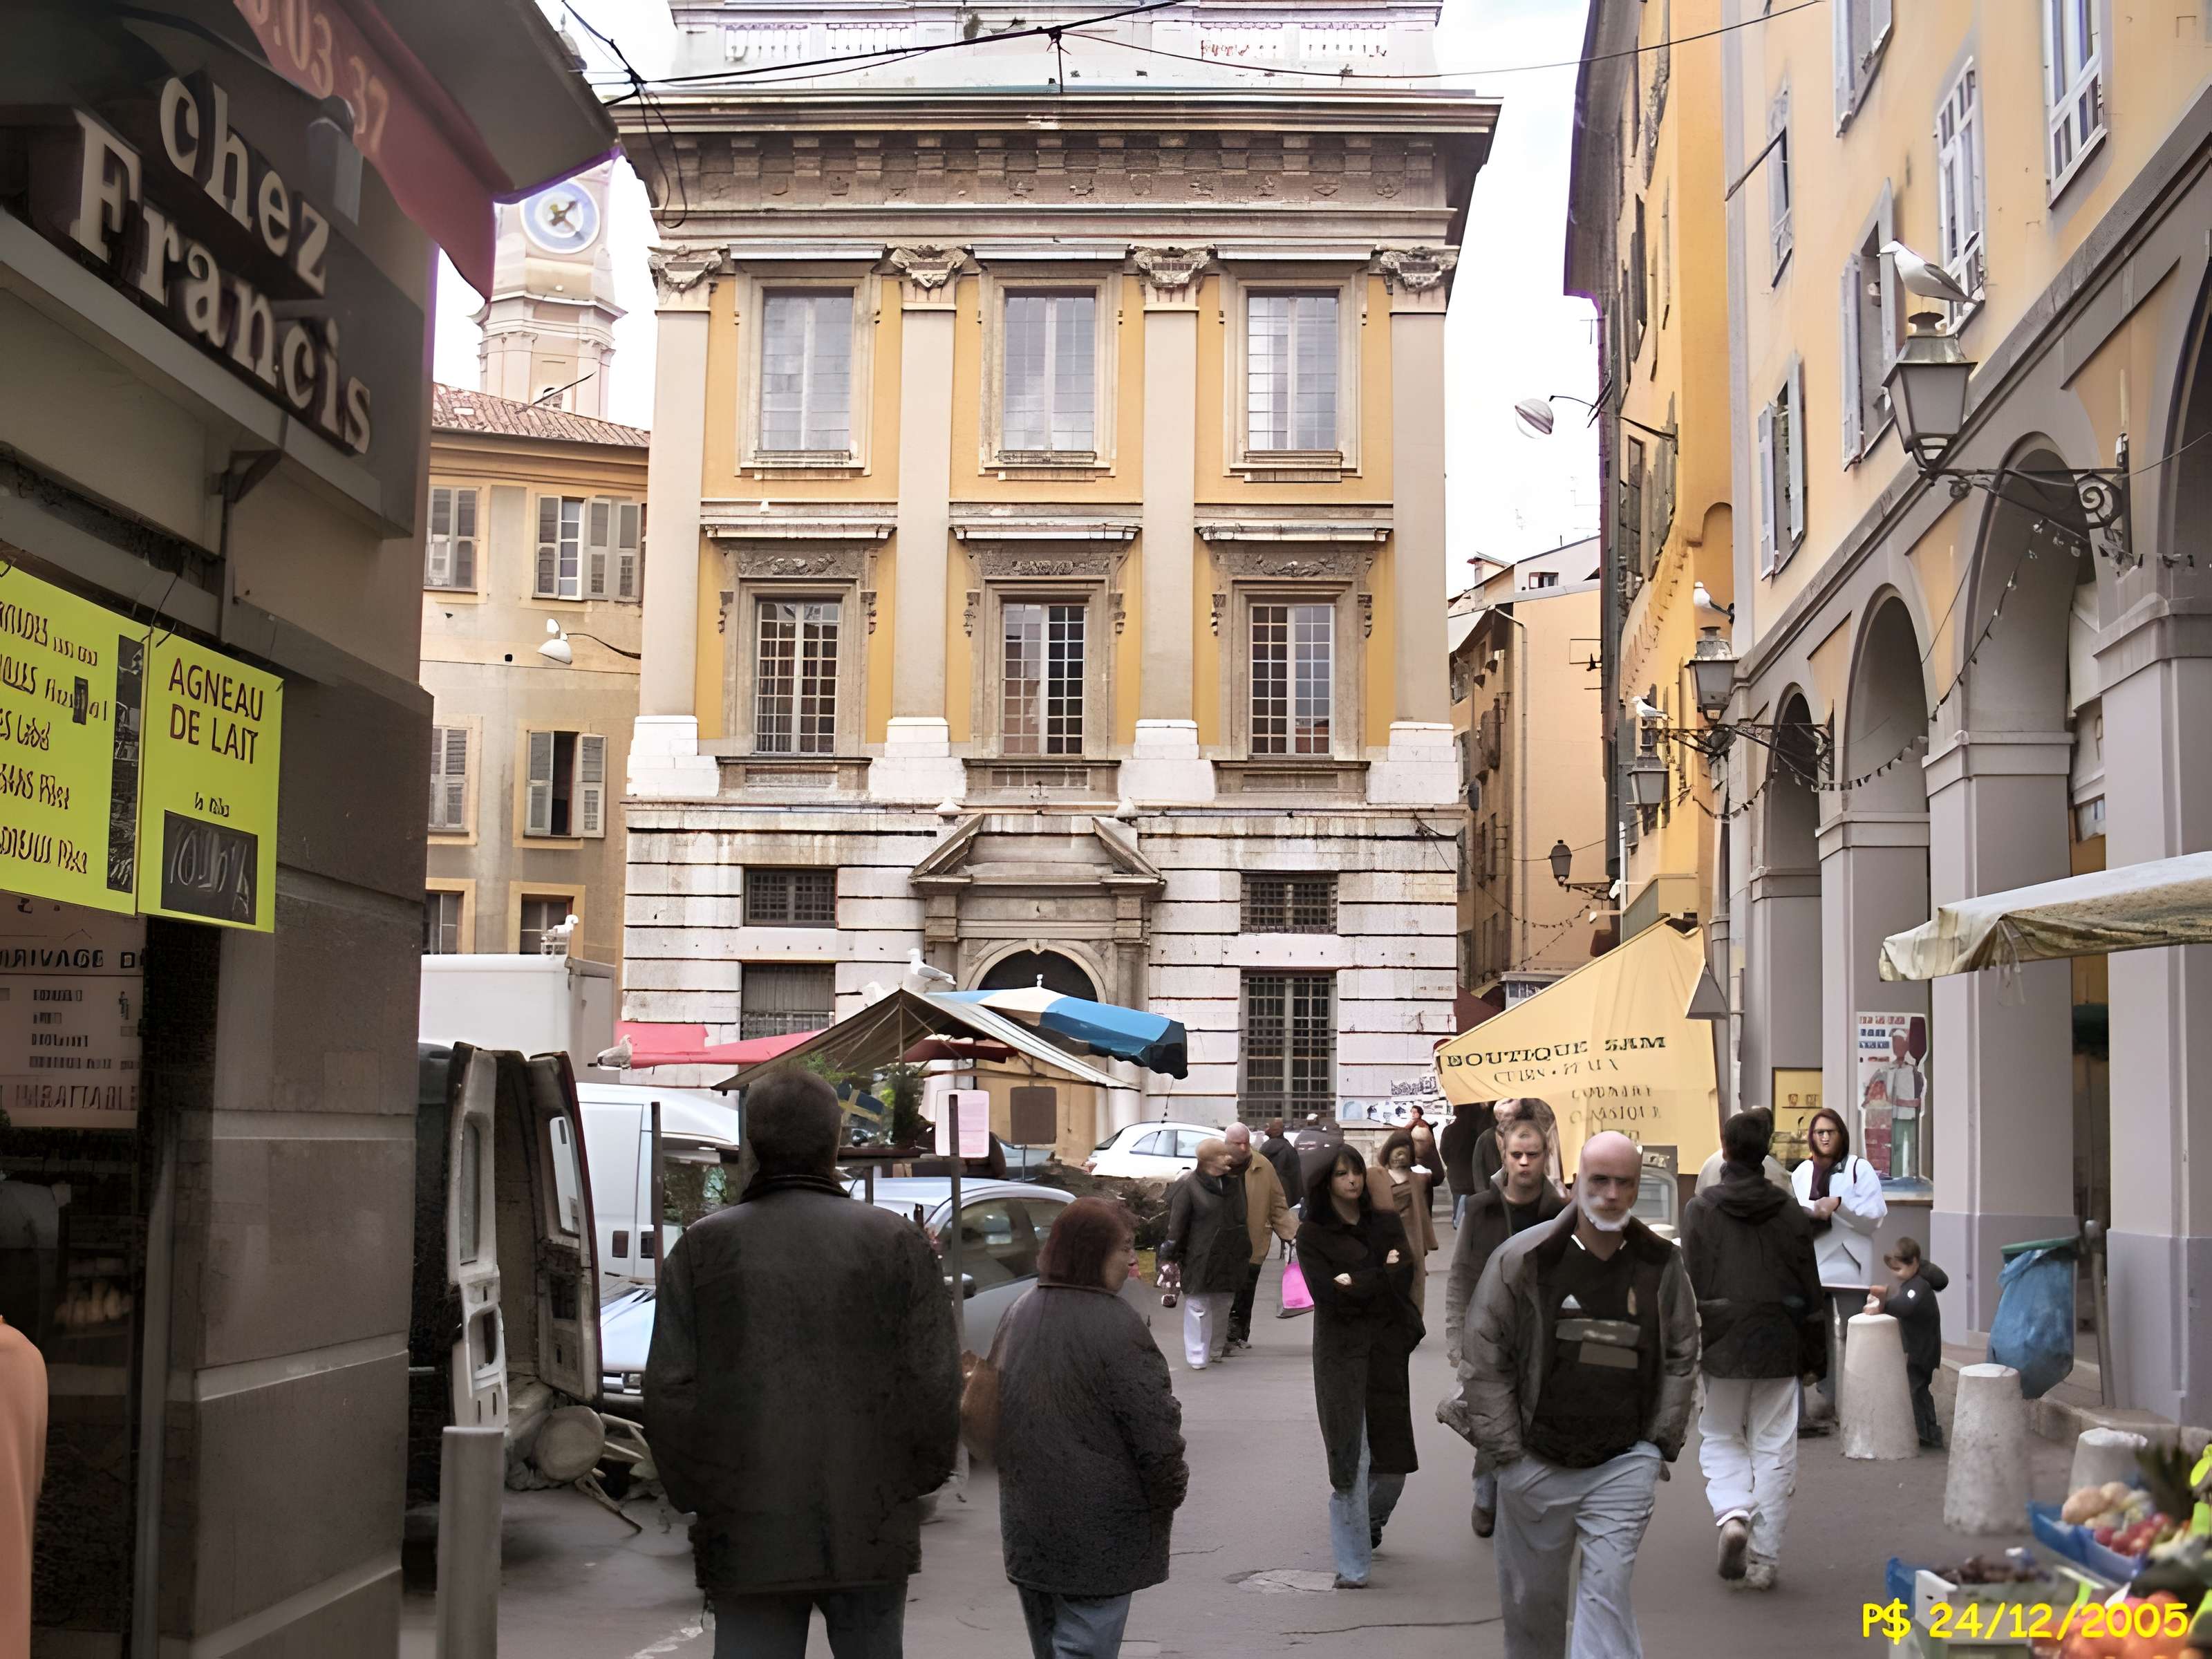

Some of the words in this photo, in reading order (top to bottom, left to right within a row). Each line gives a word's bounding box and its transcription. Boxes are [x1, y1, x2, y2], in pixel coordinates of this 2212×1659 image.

[71, 108, 371, 455] Francis
[168, 657, 264, 722] AGNEAU
[169, 703, 201, 746] DE
[210, 717, 259, 765] LAIT
[1446, 1040, 1588, 1067] BOUTIQUE
